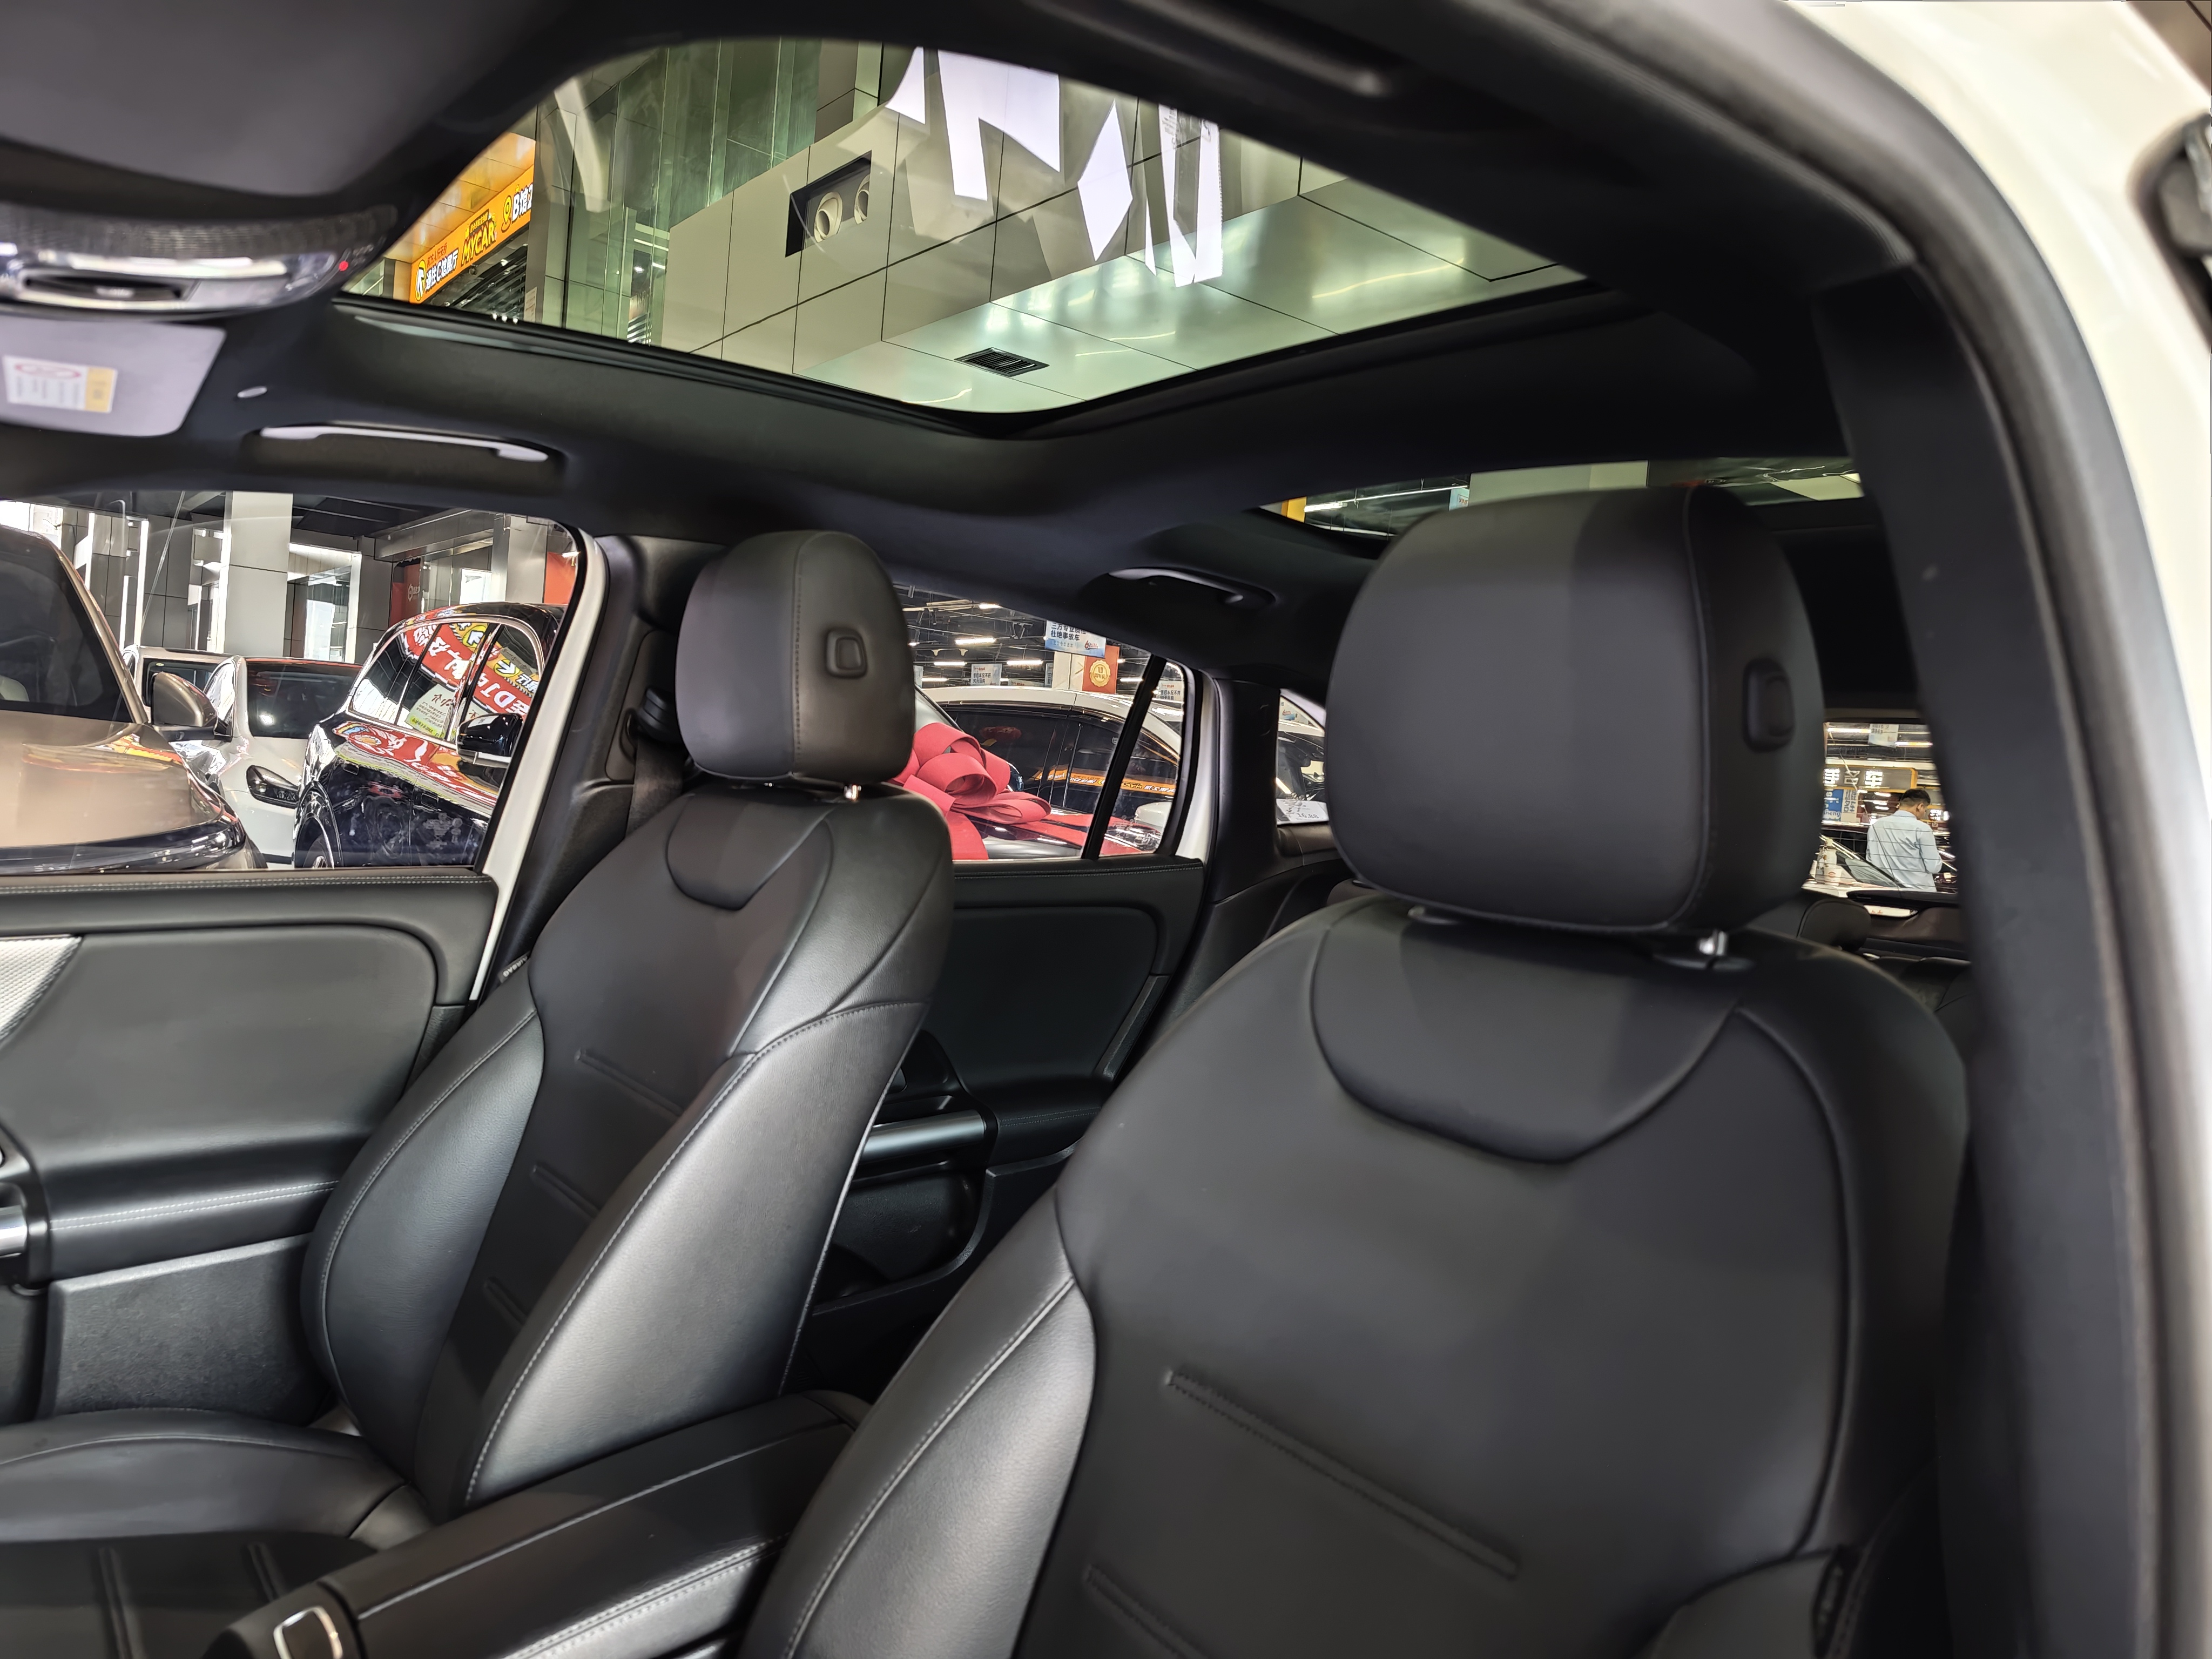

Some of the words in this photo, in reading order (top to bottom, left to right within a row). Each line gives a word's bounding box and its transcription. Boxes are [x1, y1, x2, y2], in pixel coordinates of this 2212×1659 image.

[1050, 630, 1080, 641] 杜绝事故车
